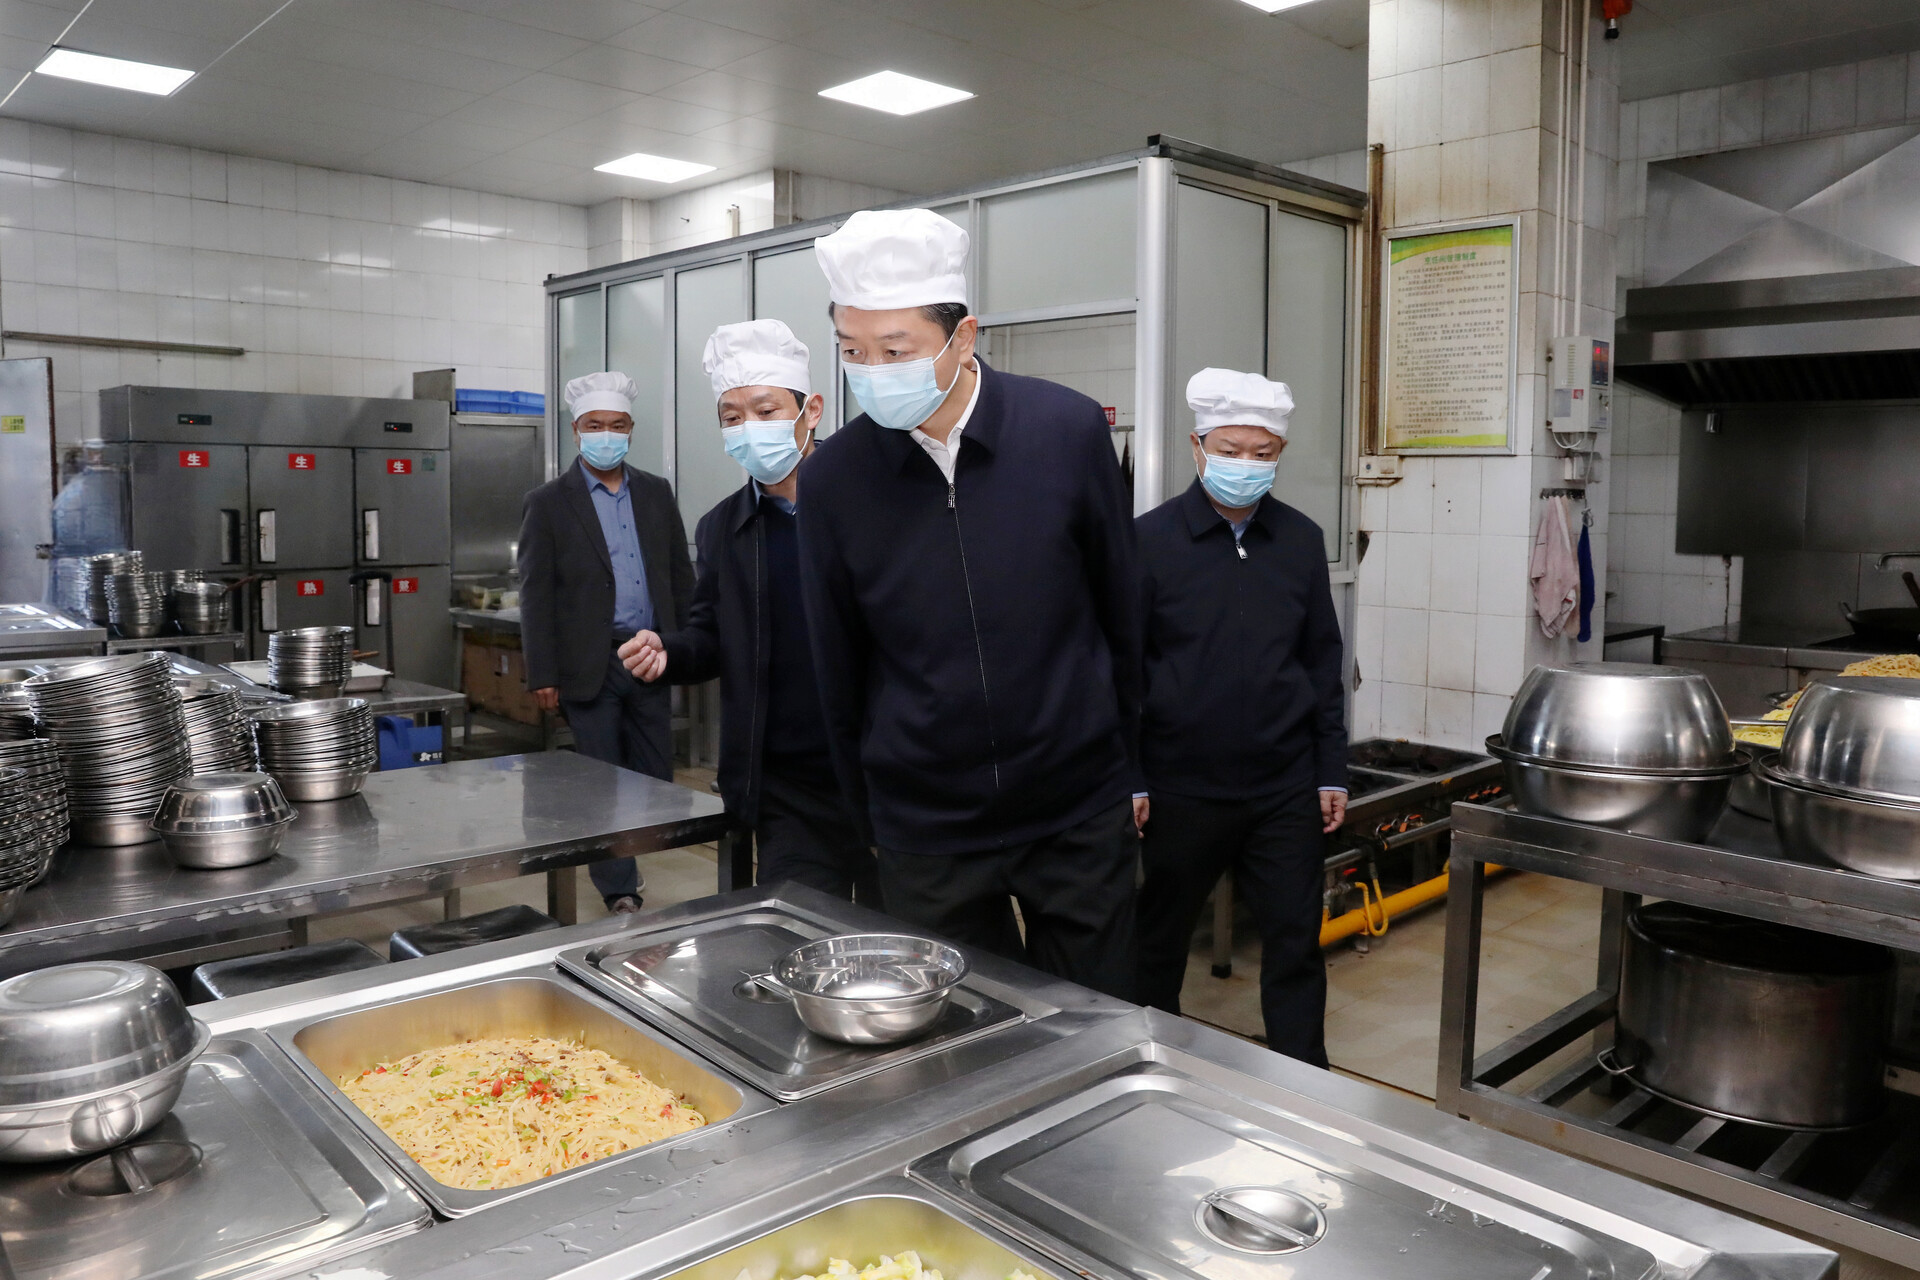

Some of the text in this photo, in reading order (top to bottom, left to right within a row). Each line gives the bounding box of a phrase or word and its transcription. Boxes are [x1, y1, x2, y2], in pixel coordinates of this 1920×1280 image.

[187, 452, 201, 466] 生
[296, 456, 308, 469] 生
[393, 461, 405, 473] 生
[304, 581, 317, 595] 熟
